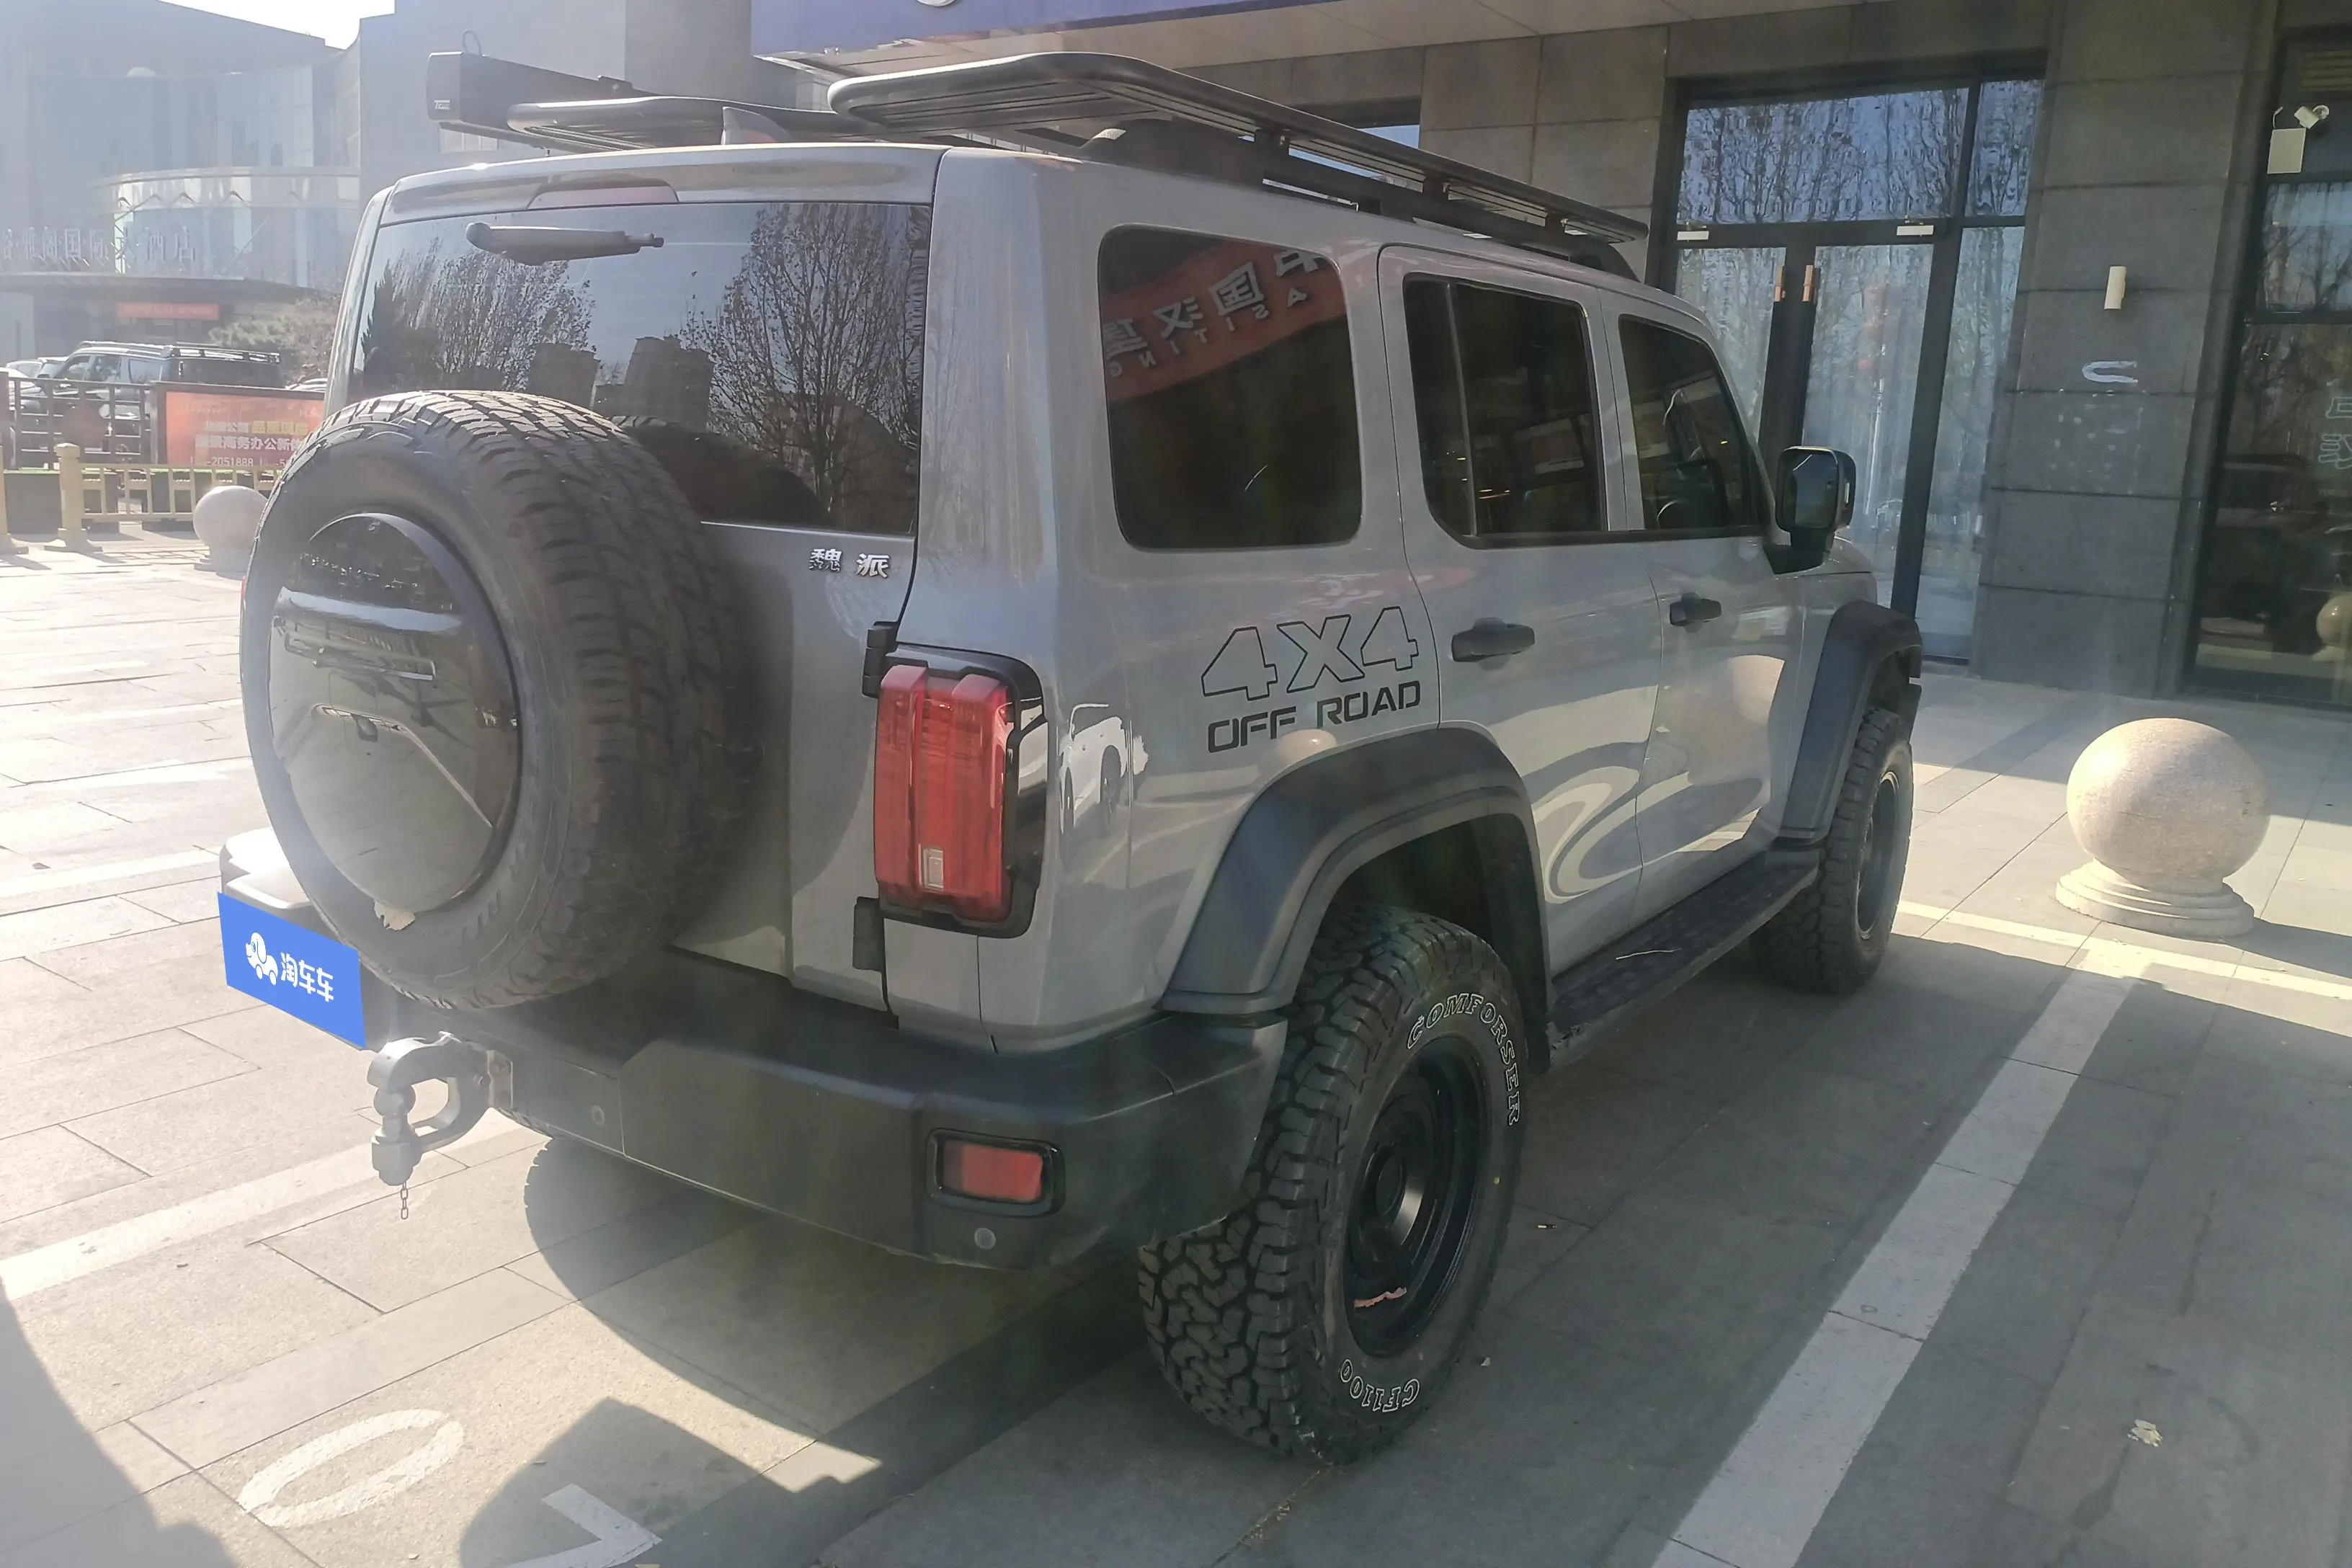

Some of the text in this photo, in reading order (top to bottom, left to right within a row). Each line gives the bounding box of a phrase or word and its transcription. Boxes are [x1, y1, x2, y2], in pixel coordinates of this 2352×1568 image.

[1208, 680, 1421, 753] OFF ROAD
[1407, 992, 1520, 1126] COMFORSER
[1340, 1358, 1420, 1412] CF1100
